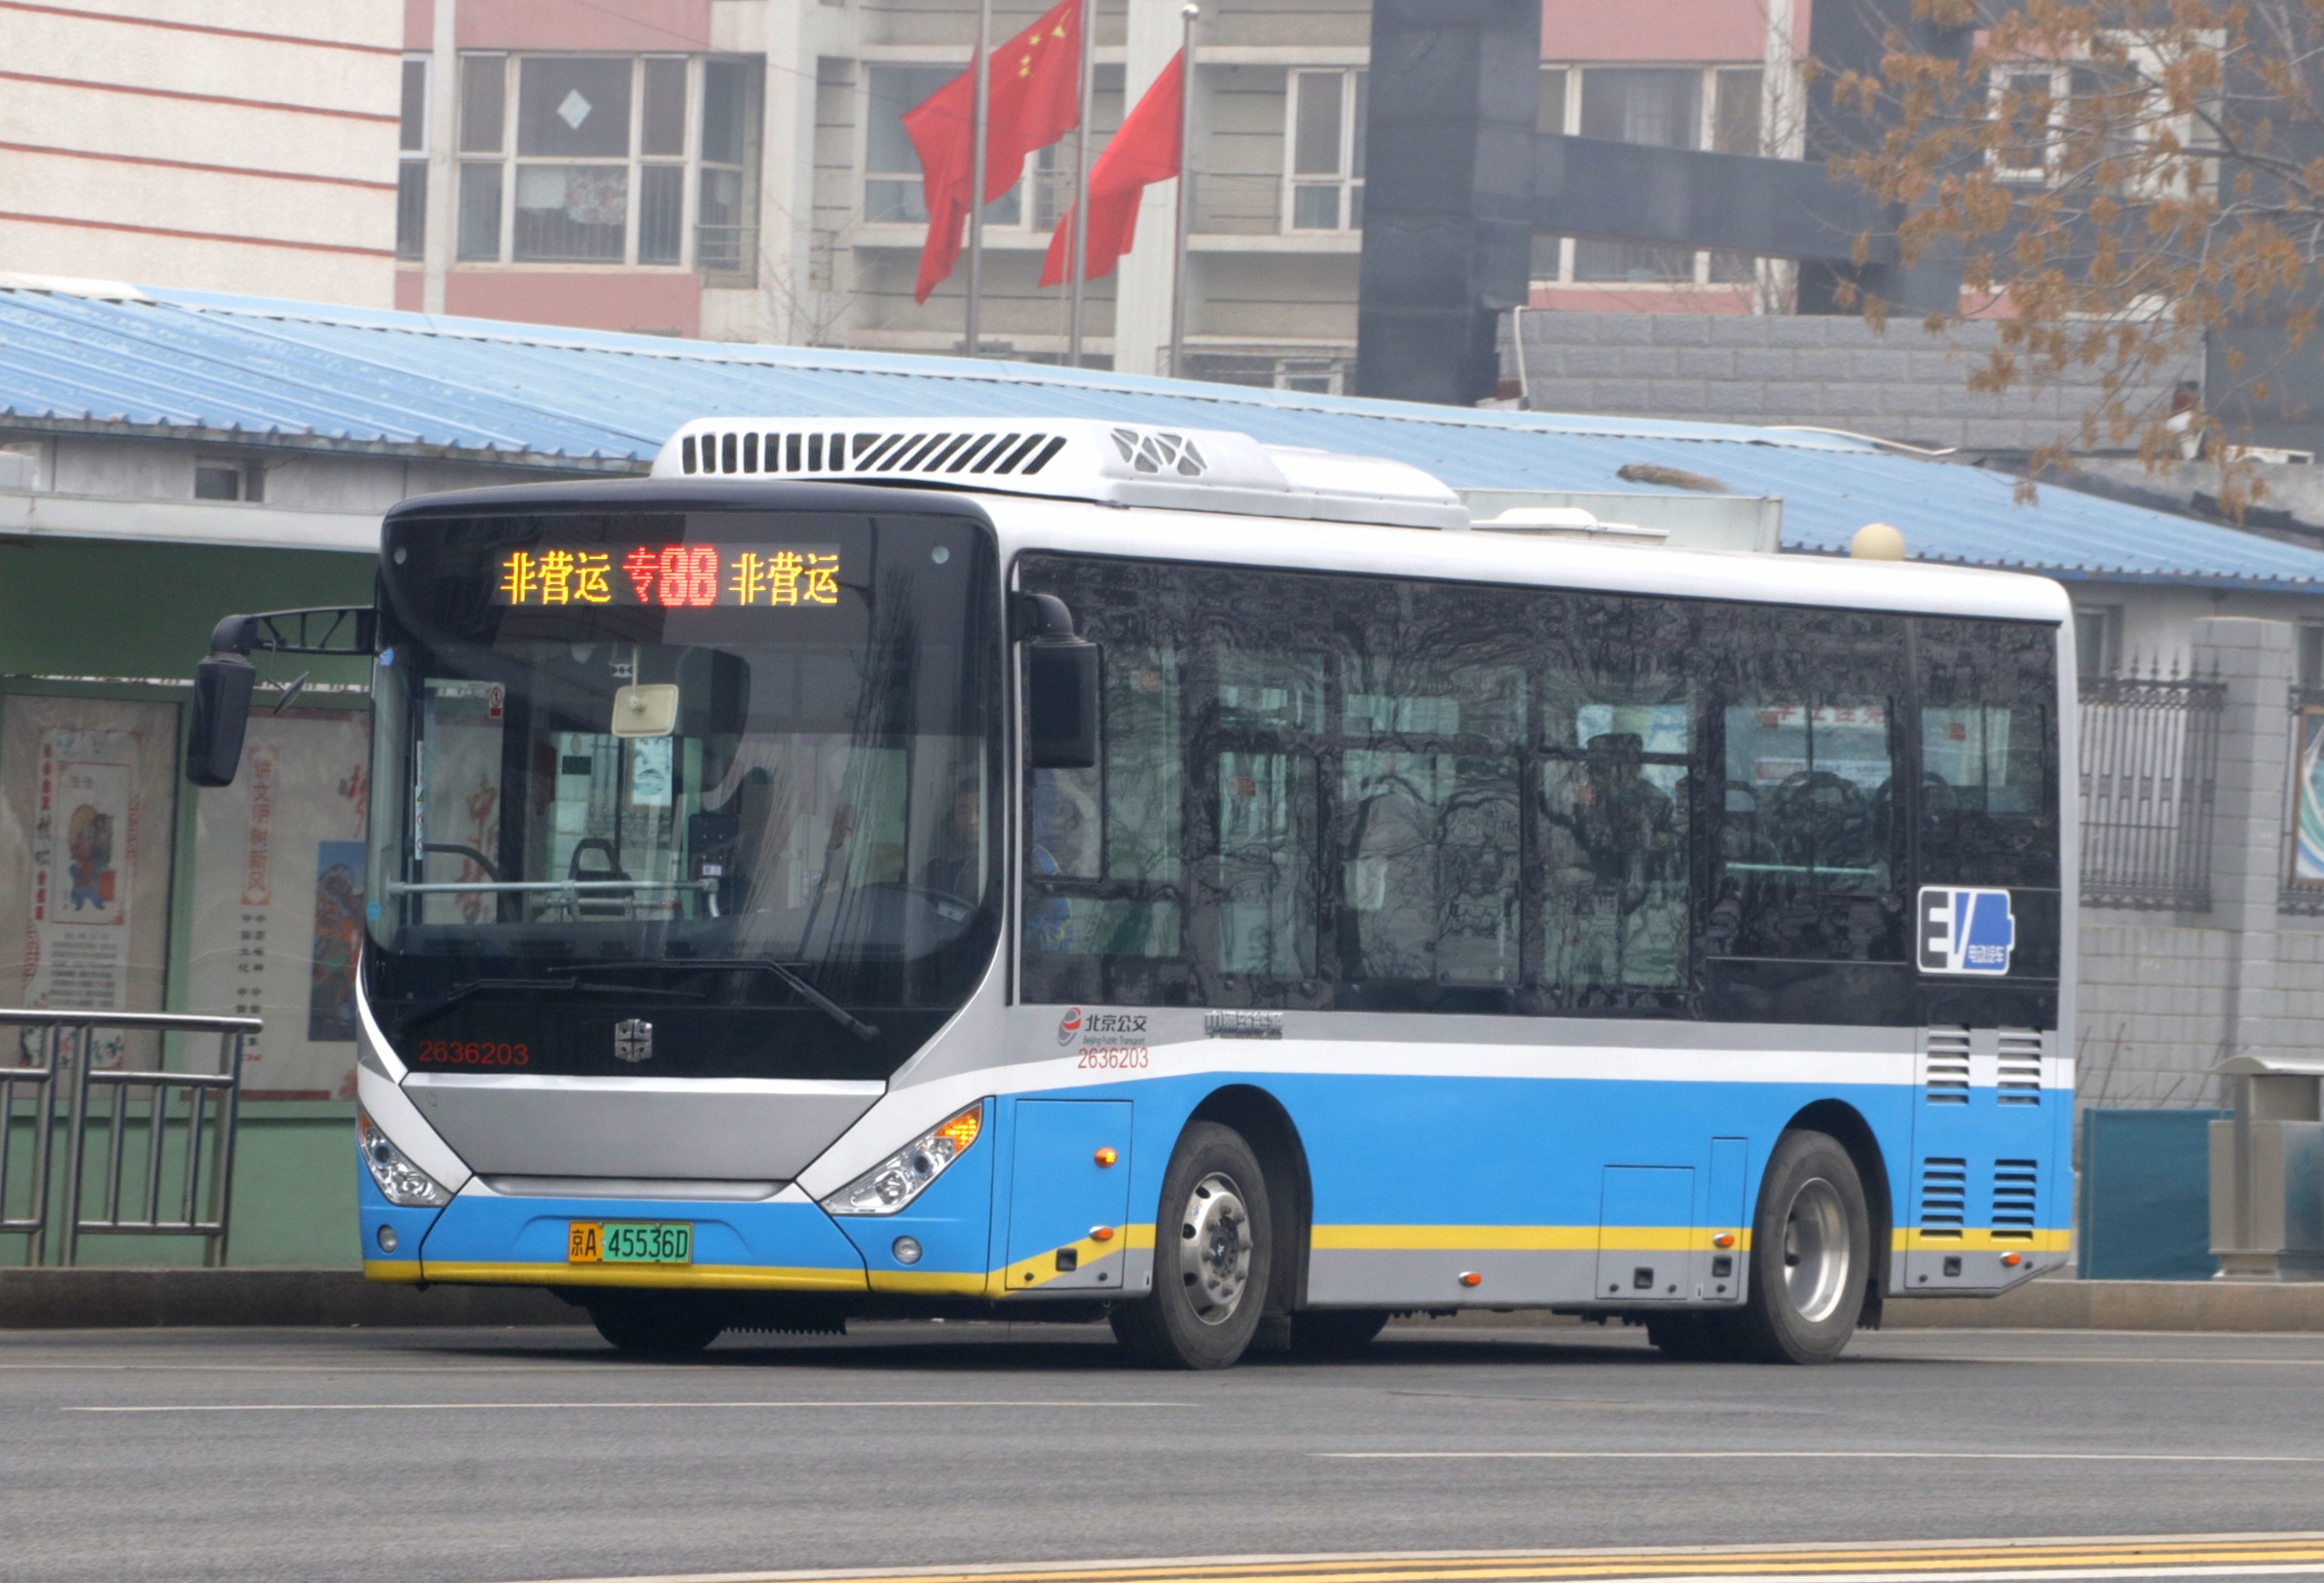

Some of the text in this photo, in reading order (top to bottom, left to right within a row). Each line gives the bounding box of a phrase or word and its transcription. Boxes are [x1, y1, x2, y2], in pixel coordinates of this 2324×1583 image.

[500, 546, 839, 607] 非营运 专88 非营运
[1085, 1013, 1148, 1033] 北京公交
[419, 1040, 529, 1065] 2636203
[1083, 1035, 1145, 1047] Beijing Public Transport
[1078, 1047, 1149, 1069] 2636203
[572, 1228, 688, 1258] 京A 45536D
